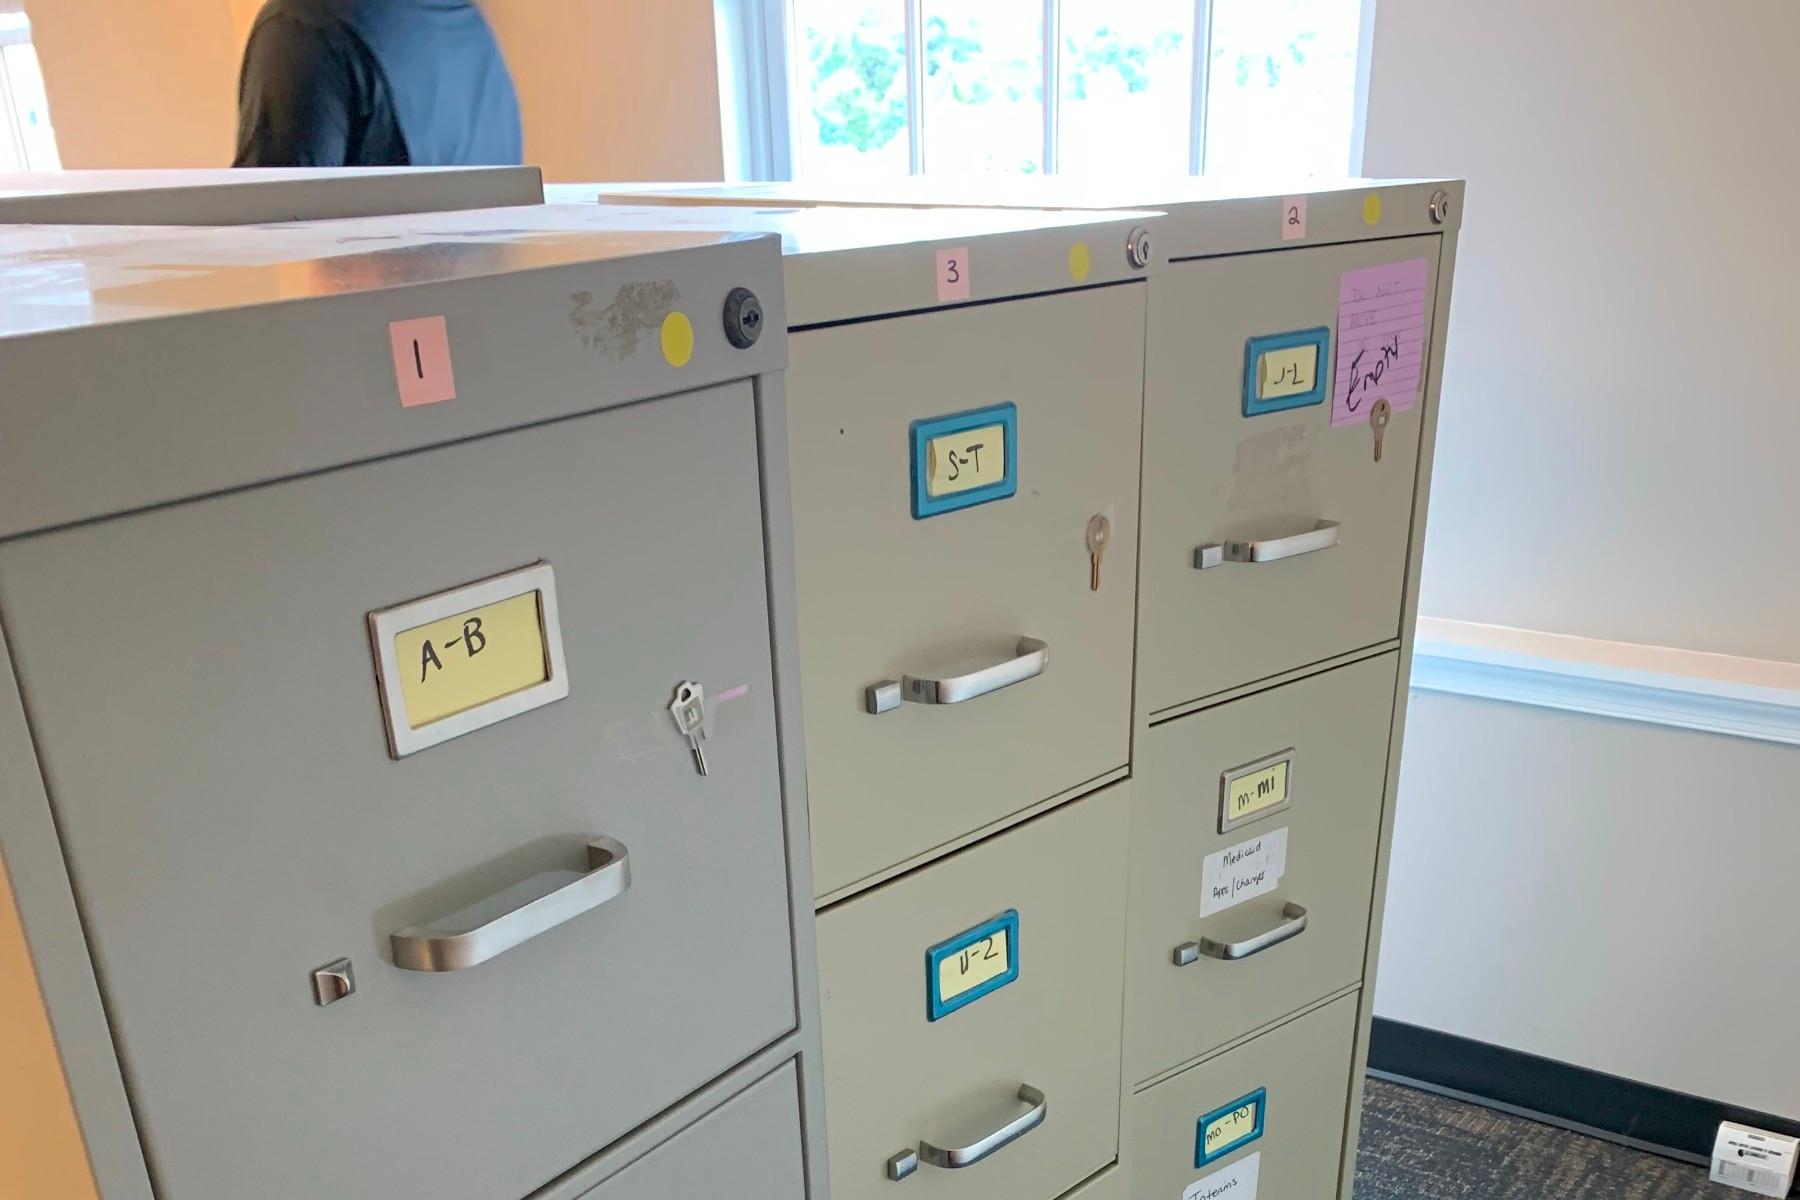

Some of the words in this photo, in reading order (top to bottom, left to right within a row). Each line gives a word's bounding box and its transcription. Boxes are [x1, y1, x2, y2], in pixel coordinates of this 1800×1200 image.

[1288, 206, 1300, 225] 2
[947, 259, 960, 283] 3
[1273, 363, 1304, 385] J-L
[948, 443, 984, 481] S-T
[420, 617, 486, 683] A-B
